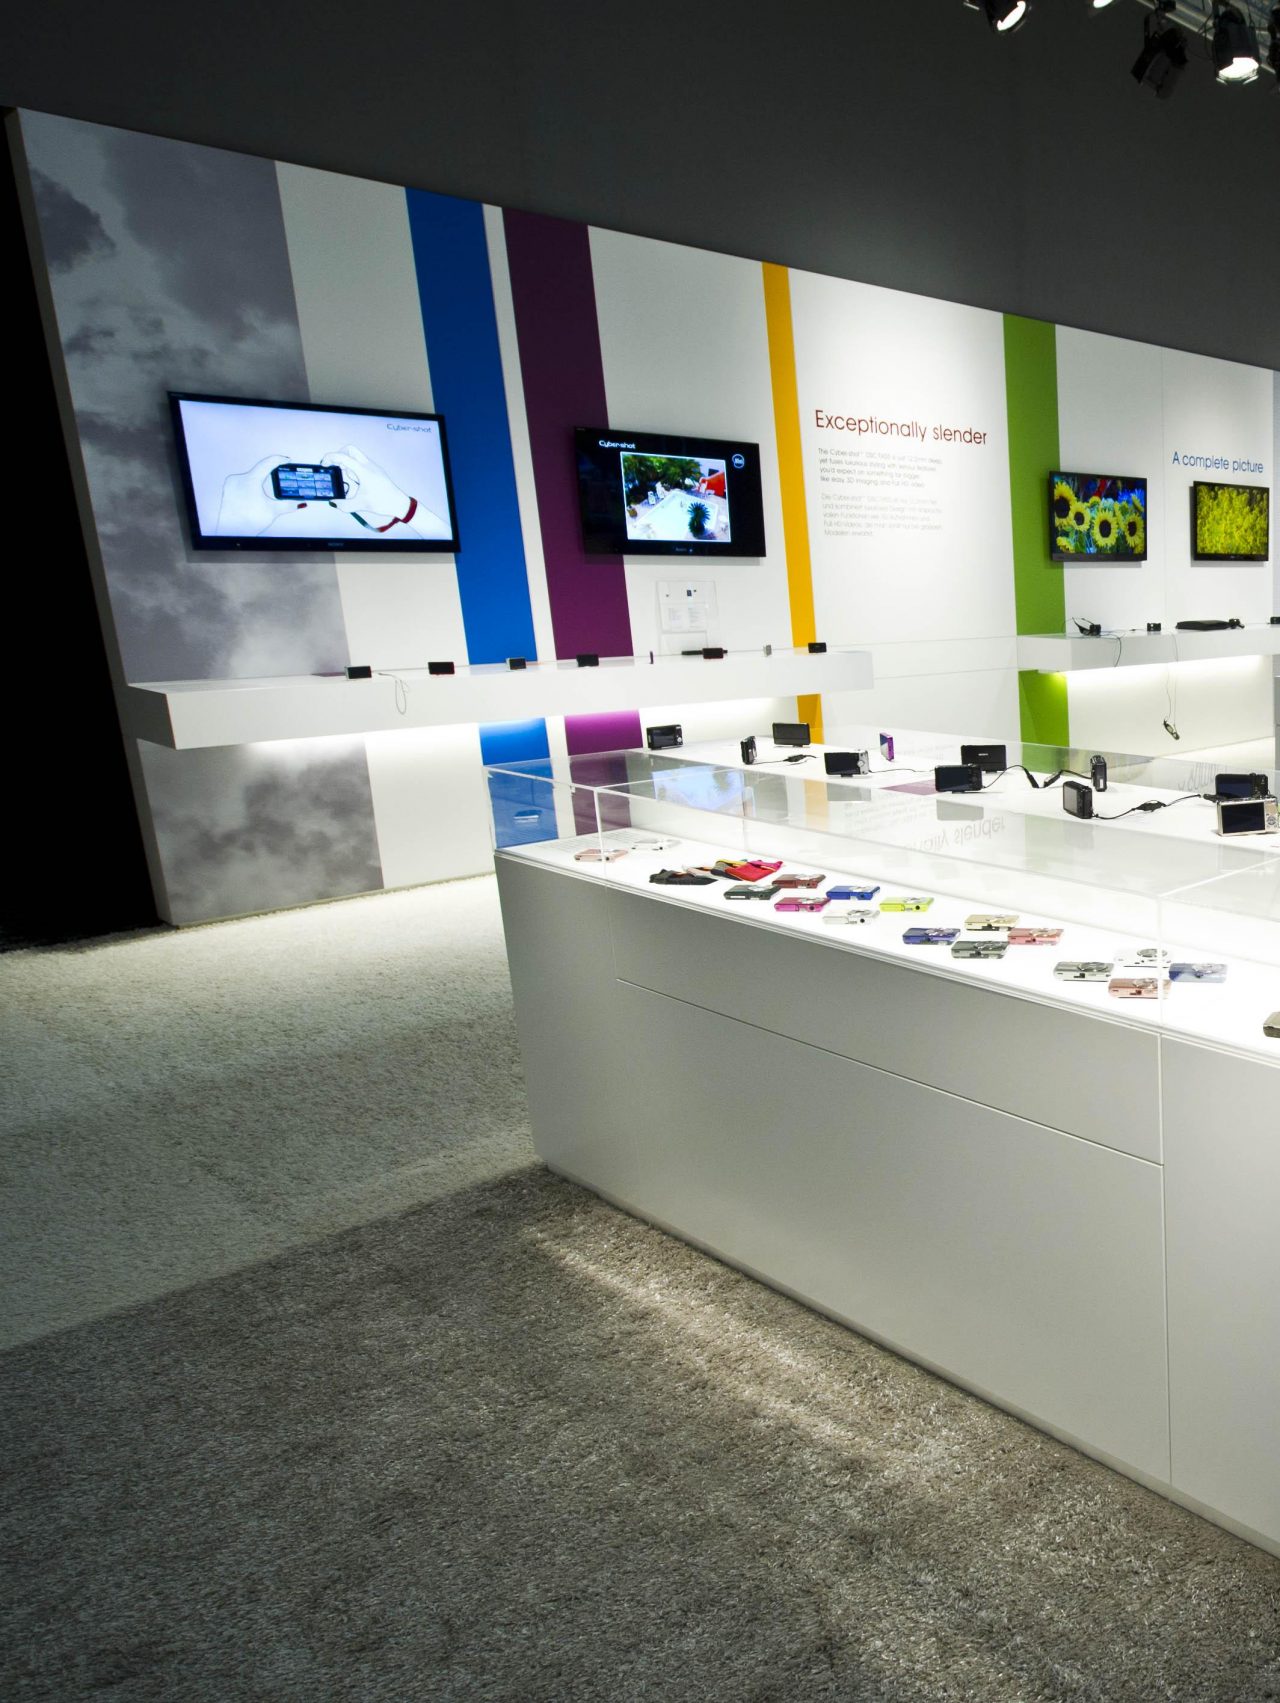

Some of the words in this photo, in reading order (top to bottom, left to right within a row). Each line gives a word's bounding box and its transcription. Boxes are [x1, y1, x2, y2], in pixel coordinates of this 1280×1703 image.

[815, 409, 927, 442] Exceptionally
[932, 424, 988, 445] slender
[598, 439, 636, 449] Cyber-shot
[1172, 451, 1180, 465] A
[1182, 455, 1230, 471] complete
[1232, 458, 1264, 473] picture
